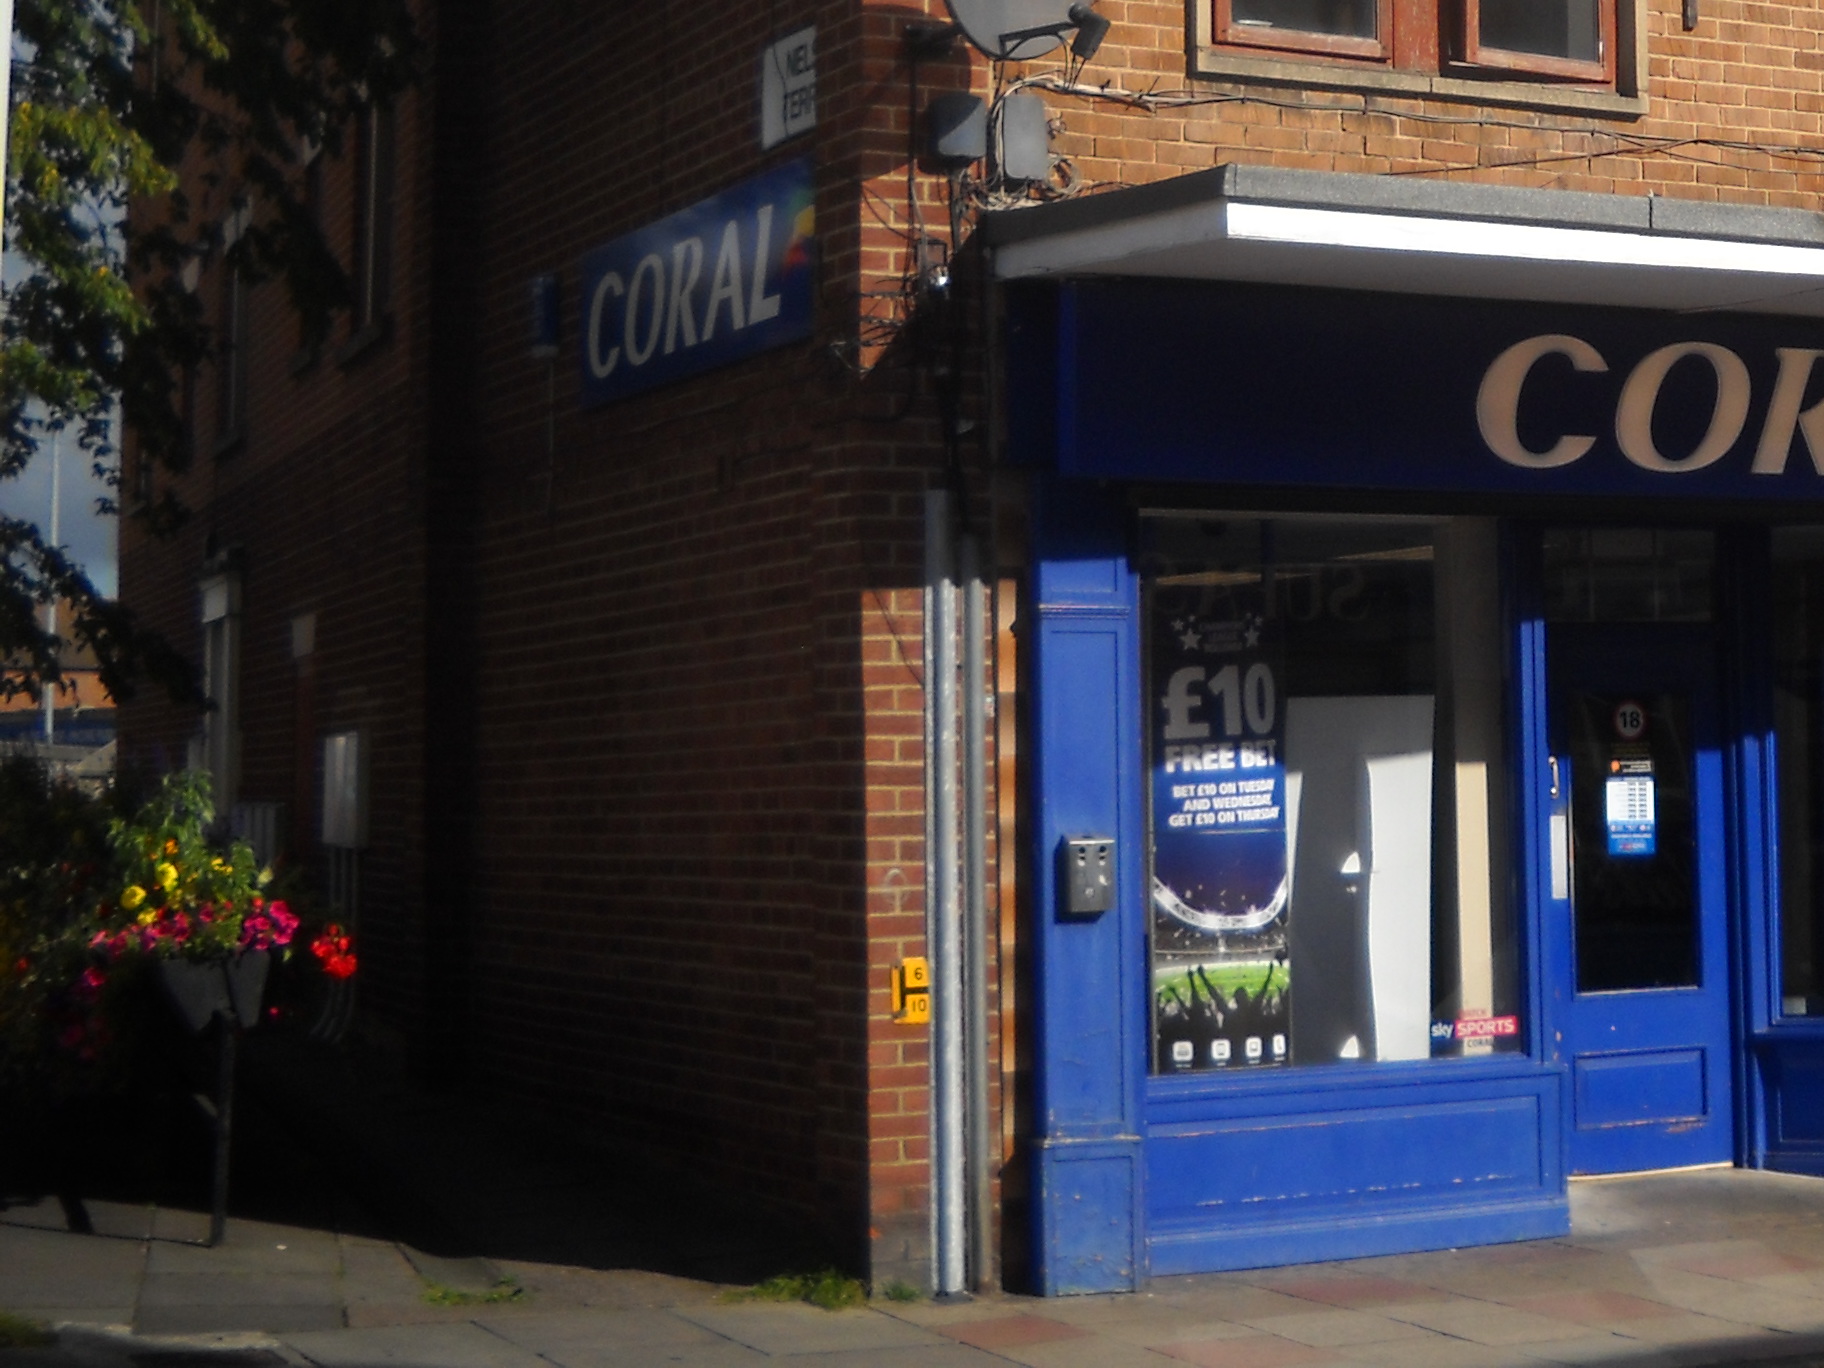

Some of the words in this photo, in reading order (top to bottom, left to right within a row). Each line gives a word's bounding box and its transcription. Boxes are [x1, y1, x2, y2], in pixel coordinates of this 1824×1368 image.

[587, 203, 782, 379] CORAL
[1161, 662, 1276, 739] £10
[1619, 711, 1640, 728] 18
[1165, 744, 1236, 773] FREE
[1241, 739, 1276, 768] BET
[1172, 785, 1196, 799] BET
[1197, 783, 1217, 797] £10
[1218, 782, 1237, 795] ON
[1237, 778, 1275, 794] TUESDAY
[1183, 797, 1211, 812] AND
[1211, 793, 1272, 810] WEDNESDAY
[1168, 813, 1193, 828] GET
[1195, 811, 1215, 826] £10
[1216, 810, 1235, 824] ON
[1236, 806, 1281, 822] THURSDAY
[914, 967, 923, 981] 6
[912, 998, 927, 1012] 10
[1431, 1022, 1453, 1040] sky
[1456, 1018, 1515, 1037] SPORTS
